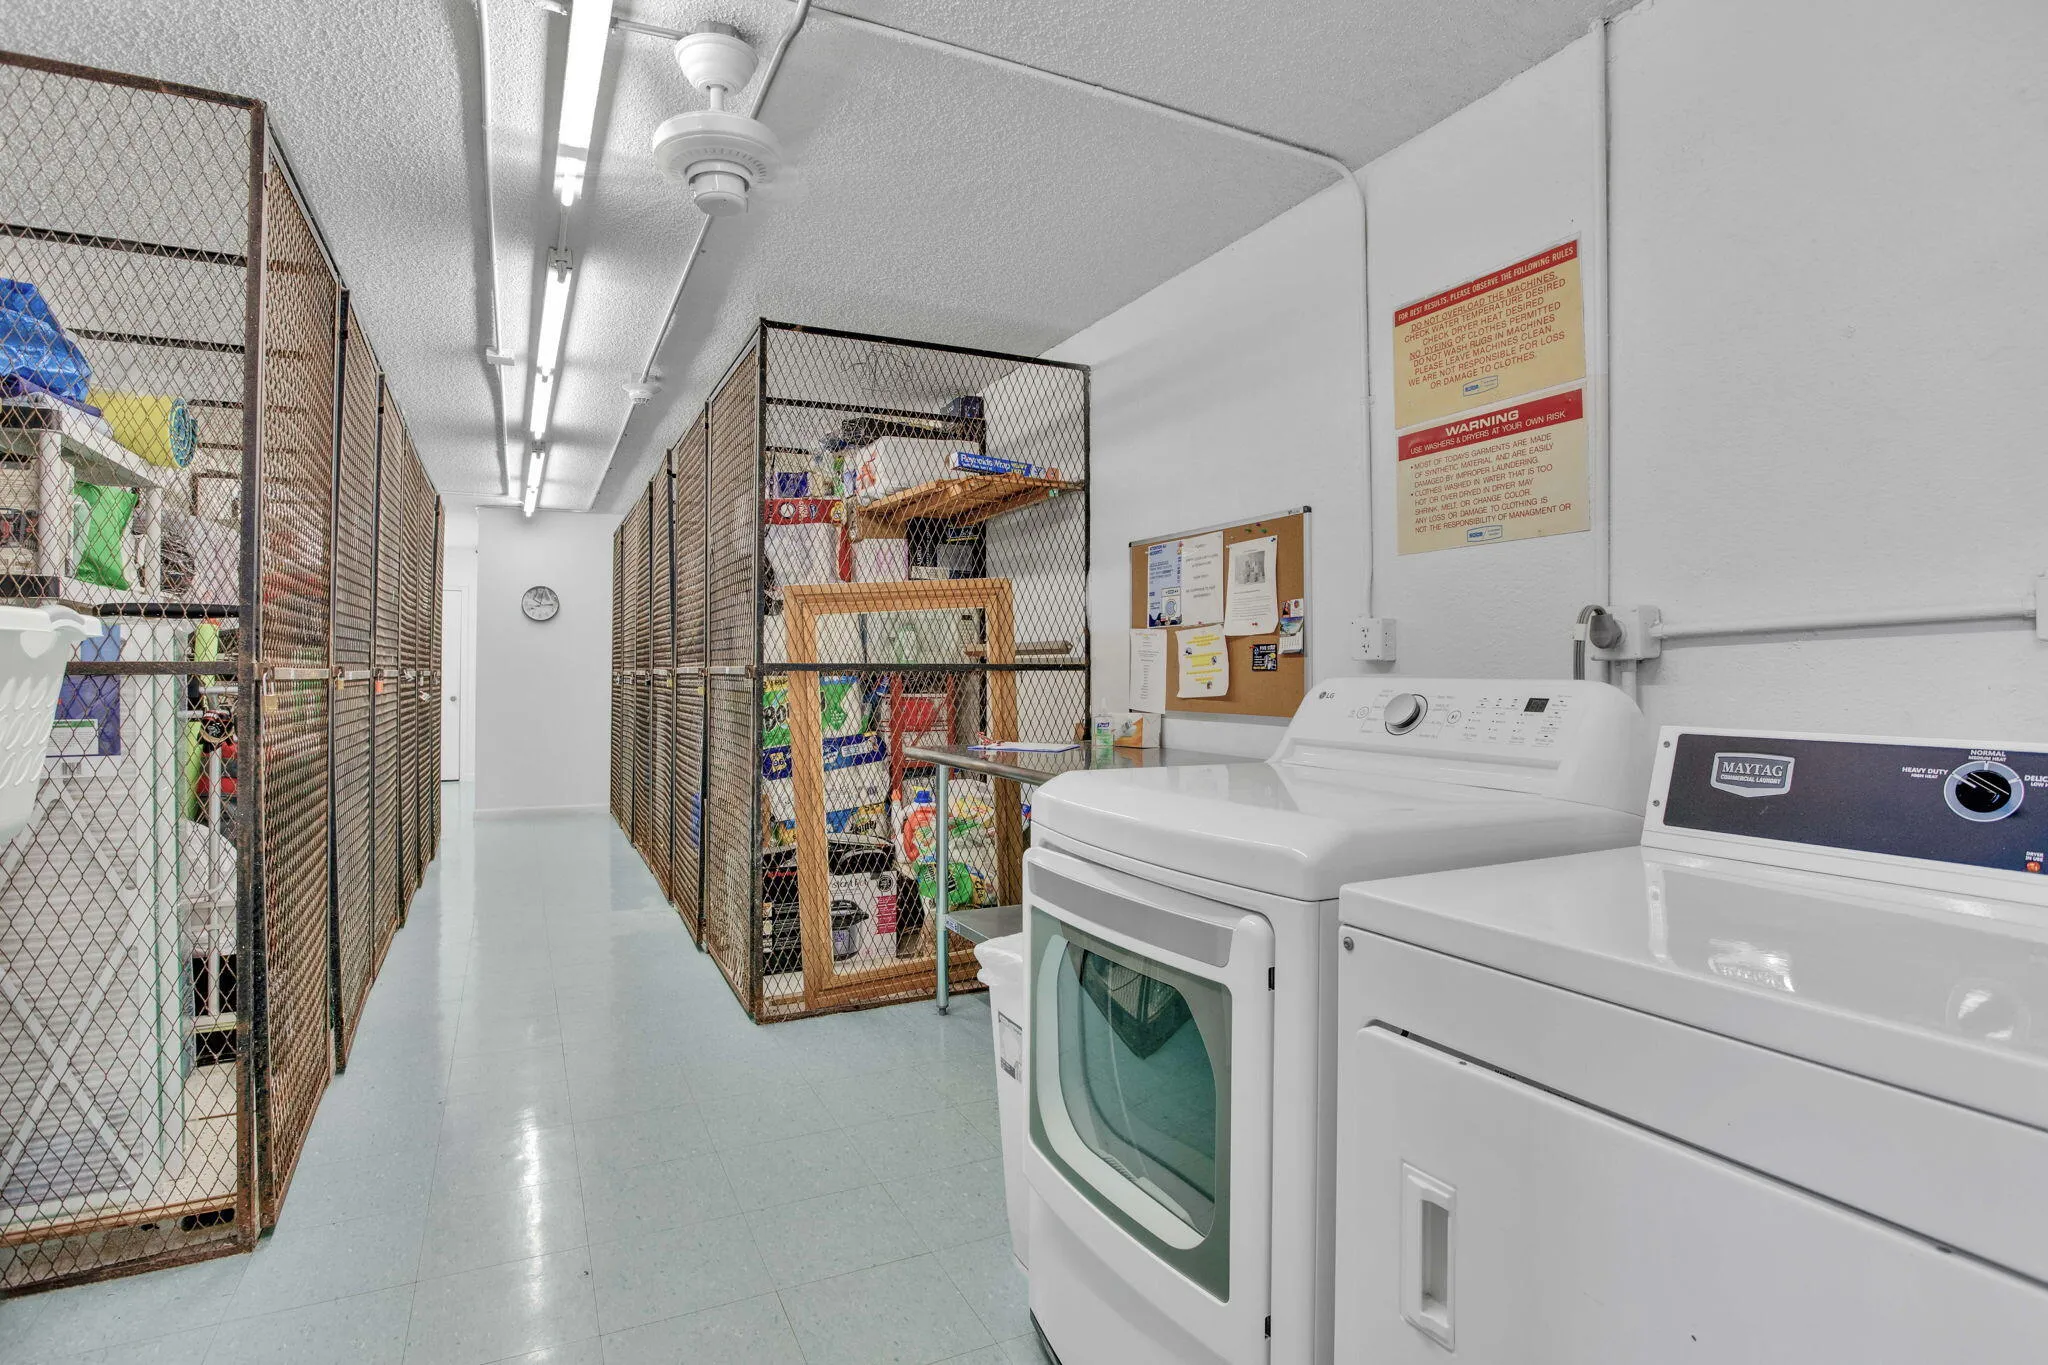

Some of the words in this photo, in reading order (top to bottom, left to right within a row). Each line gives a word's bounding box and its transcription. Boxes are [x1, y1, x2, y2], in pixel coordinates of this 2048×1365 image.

[1398, 313, 1409, 321] FOR
[1410, 306, 1422, 316] BEST
[1450, 288, 1470, 301] PLEASE
[1472, 276, 1498, 292] OBSERVE
[1501, 271, 1512, 281] THE
[1514, 256, 1550, 276] FOLLOWING
[1552, 247, 1573, 262] RULES
[1405, 330, 1429, 342] CHECK
[1432, 318, 1459, 332] WATER
[1462, 294, 1523, 322] TEMPERATURE
[1526, 279, 1566, 299] DESIRED
[1411, 322, 1422, 332] DO
[1424, 315, 1439, 325] NOT
[1442, 298, 1485, 319] OVERLOAD
[1487, 291, 1504, 302] THE
[1423, 332, 1449, 345] CHECK
[1452, 321, 1478, 335] DRYER
[1481, 311, 1503, 325] HEAT
[1506, 297, 1544, 316] DESIRED
[1410, 350, 1420, 359] NO
[1424, 339, 1452, 354] DYEING
[1455, 334, 1465, 343] OF
[1468, 320, 1506, 339] CLOTHES
[1510, 302, 1560, 325] PERMITTED
[1414, 358, 1424, 367] DO
[1426, 352, 1442, 361] NOT
[1444, 344, 1467, 357] WASH
[1470, 335, 1492, 347] RUGS
[1495, 332, 1503, 340] IN
[1507, 314, 1555, 336] MACHINES
[1409, 377, 1420, 387] WE
[1422, 372, 1437, 383] ARE
[1440, 366, 1456, 376] NOT
[1459, 347, 1516, 371] RESPONSIBLE
[1520, 340, 1538, 352] FOR
[1541, 331, 1565, 345] LOSS
[1415, 361, 1444, 375] PLEASE
[1446, 352, 1470, 365] LEAVE
[1473, 336, 1518, 356] MACHINES
[1521, 325, 1552, 340] CLEAN
[1431, 380, 1441, 389] OR
[1444, 369, 1478, 386] DAMAGE
[1481, 365, 1491, 374] TO
[1494, 351, 1535, 370] CLOTHES
[1411, 446, 1422, 454] USE
[1424, 438, 1454, 451] WASHERS
[1462, 430, 1489, 442] DRYERS
[1492, 426, 1500, 434] AT
[1502, 421, 1522, 432] YOUR
[1526, 416, 1544, 426] OWN
[1547, 411, 1566, 420] RISK
[1446, 410, 1519, 436] WARNING
[1414, 460, 1431, 469] MOST
[1434, 458, 1442, 466] OF
[1471, 443, 1510, 457] GARMENTS
[1513, 438, 1528, 448] ARE
[1530, 433, 1552, 444] MADE
[1424, 464, 1458, 476] SYNTHETIC
[1496, 453, 1510, 461] AND
[1512, 449, 1527, 459] ARE
[1529, 442, 1554, 454] EASILY
[1415, 477, 1443, 488] DAMAGED
[1456, 467, 1490, 479] IMPROPER
[1415, 486, 1442, 497] CLOTHES
[1444, 481, 1471, 490] WASHED
[1483, 473, 1505, 483] WATER
[1509, 469, 1525, 478] THAT
[1537, 464, 1552, 473] TOO
[1415, 498, 1426, 506] HOT
[1492, 482, 1515, 492] DRYER
[1518, 478, 1534, 486] MAY
[1429, 514, 1445, 522] LOSS
[1461, 507, 1487, 517] DAMAGE
[1502, 498, 1537, 510] CLOTHING
[1444, 515, 1496, 528] RESPONSIBILITY
[1509, 505, 1556, 519] MANAGMENT
[1559, 503, 1571, 511] OR
[1473, 494, 1501, 504] CHANGE
[1721, 774, 1754, 782] COMMERCIAL
[1722, 762, 1783, 776] MAYTAG
